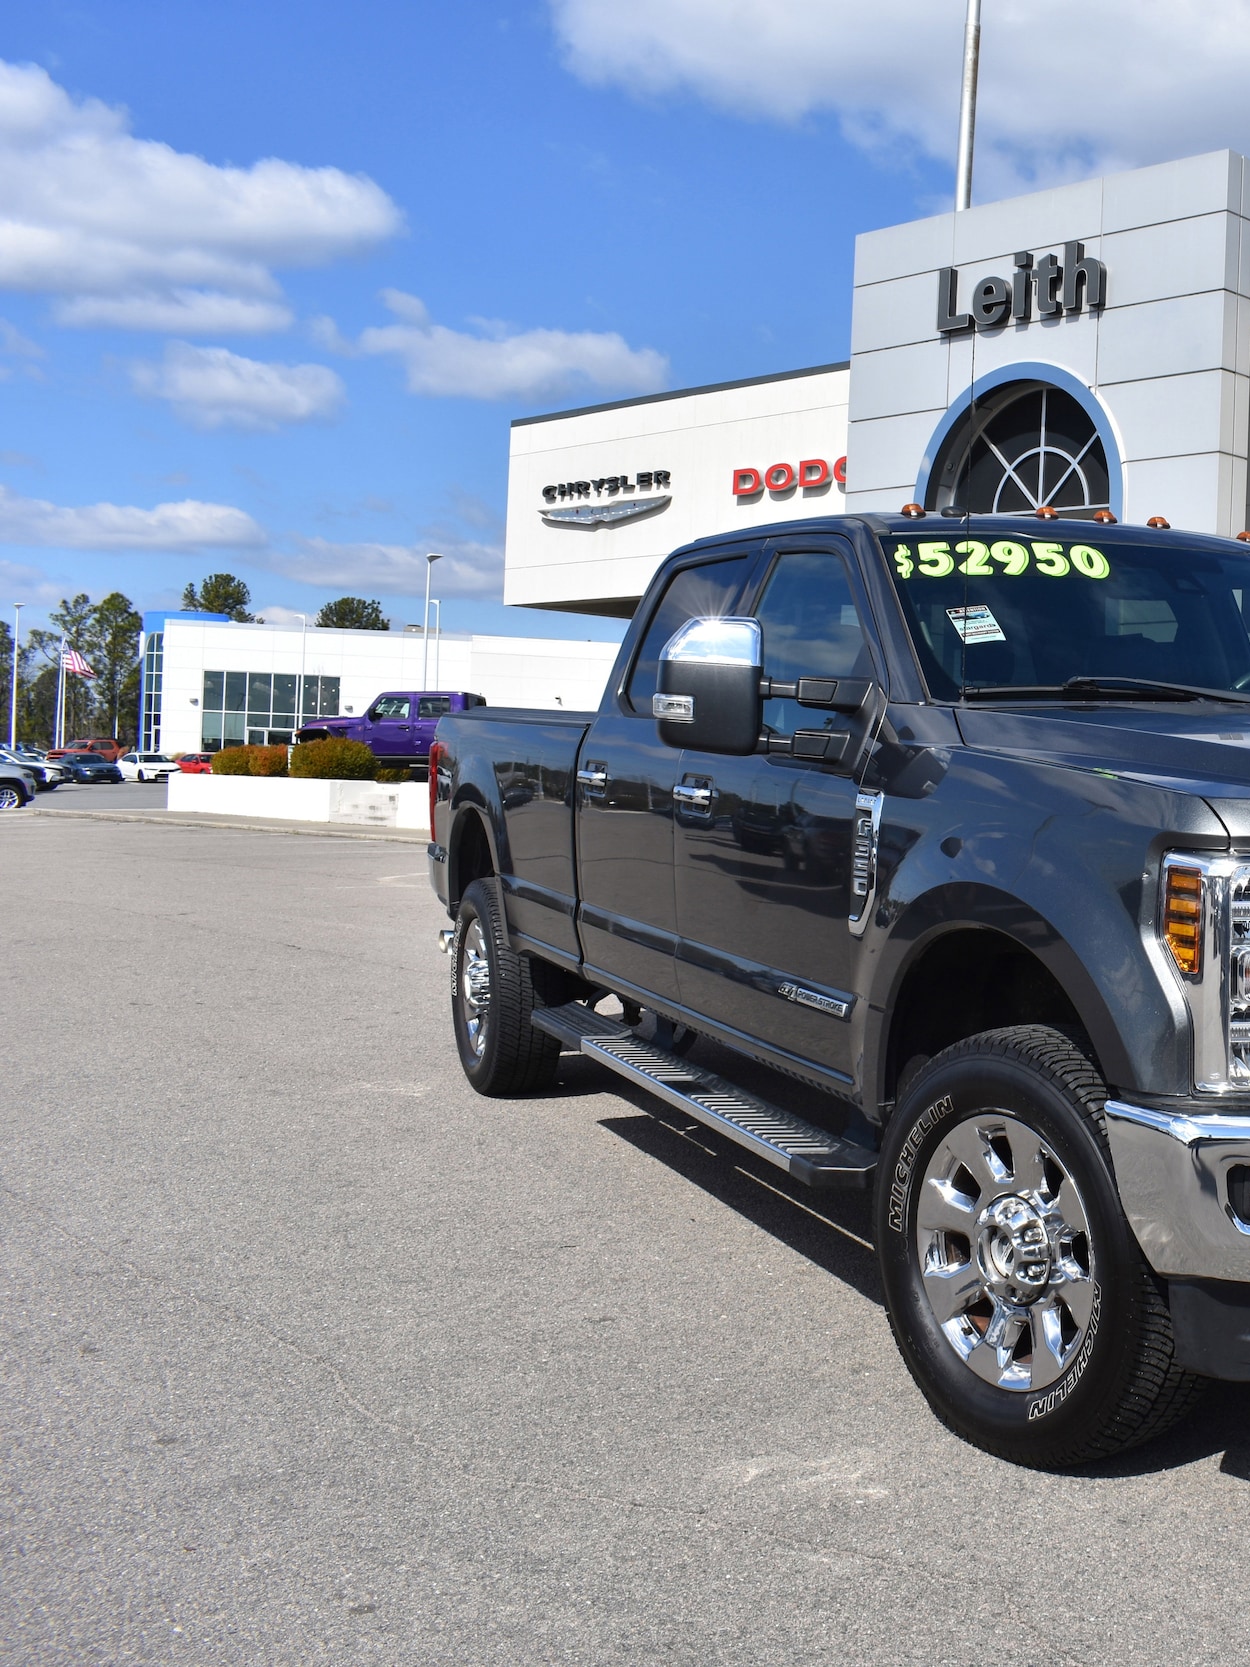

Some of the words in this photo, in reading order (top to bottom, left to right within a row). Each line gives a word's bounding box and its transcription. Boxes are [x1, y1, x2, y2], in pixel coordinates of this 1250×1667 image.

[937, 241, 1107, 332] Leith
[541, 470, 671, 499] CHRYSLER
[894, 540, 1111, 579] $52950
[889, 1094, 955, 1232] MICHELIN
[1028, 1280, 1102, 1420] MICHELIN
